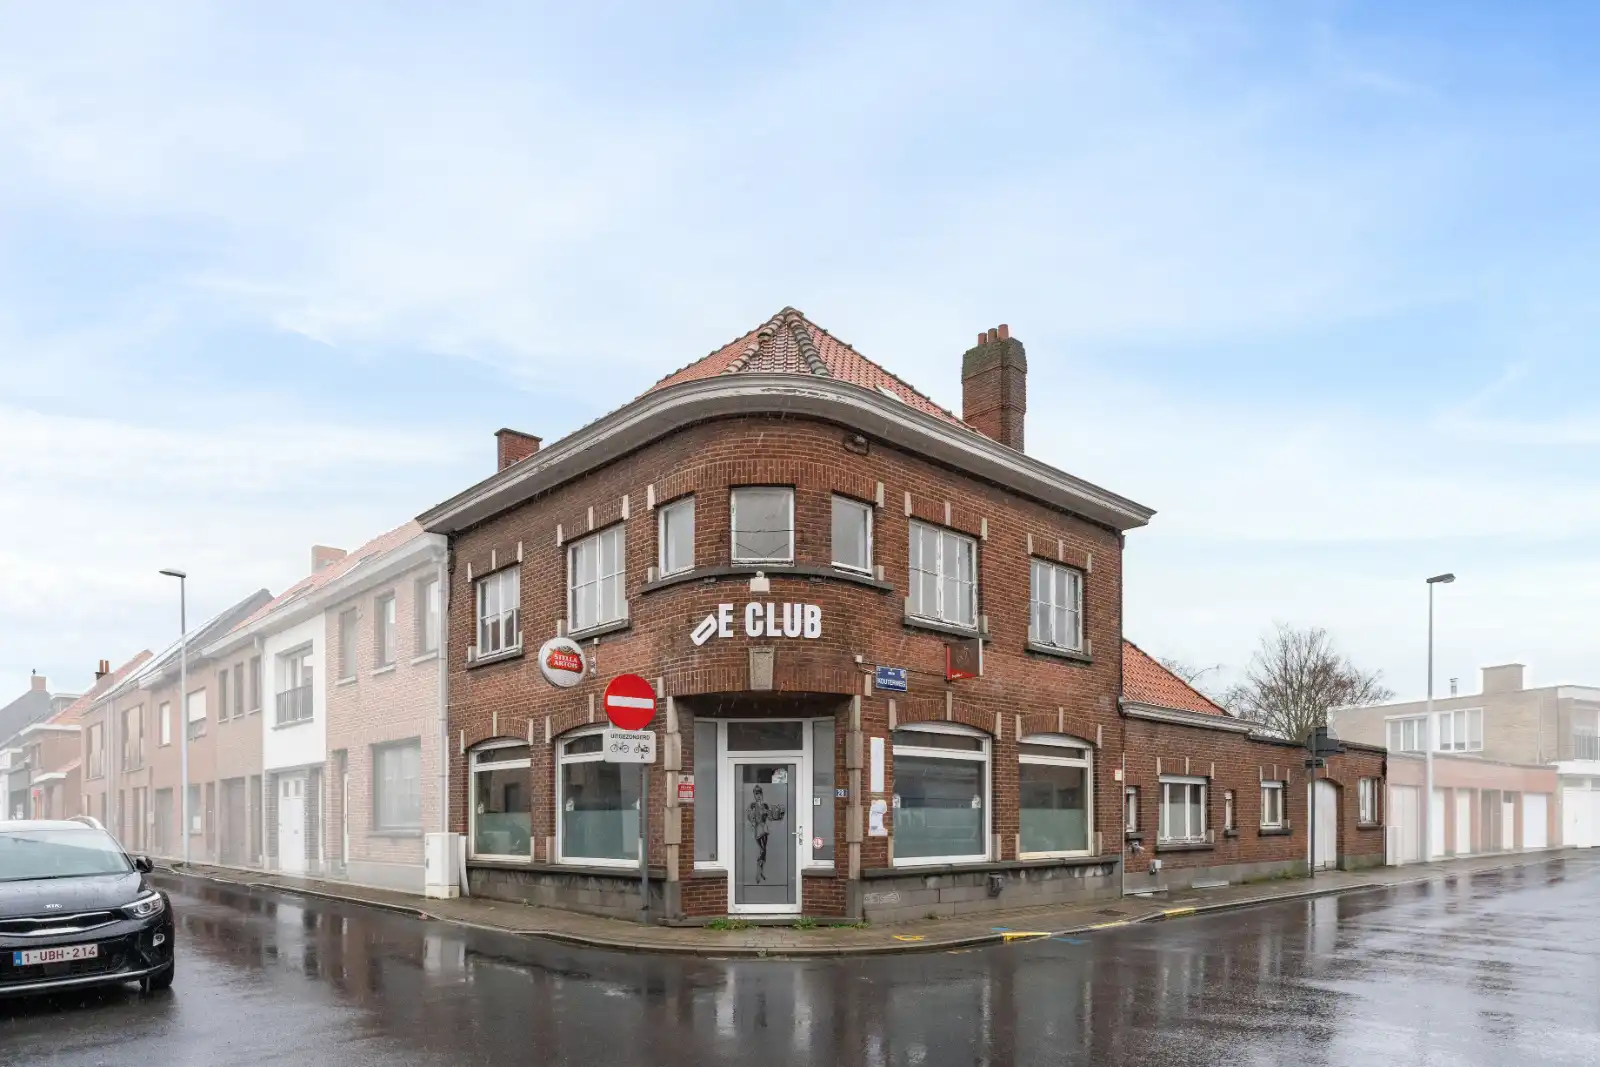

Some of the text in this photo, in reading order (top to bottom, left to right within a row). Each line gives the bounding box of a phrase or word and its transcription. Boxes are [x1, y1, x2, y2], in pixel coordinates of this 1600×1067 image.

[690, 602, 822, 646] DE CLUB
[554, 653, 578, 663] STELLA
[610, 733, 651, 741] UITGEZONDERD
[24, 946, 96, 963] 1-UBH-214
